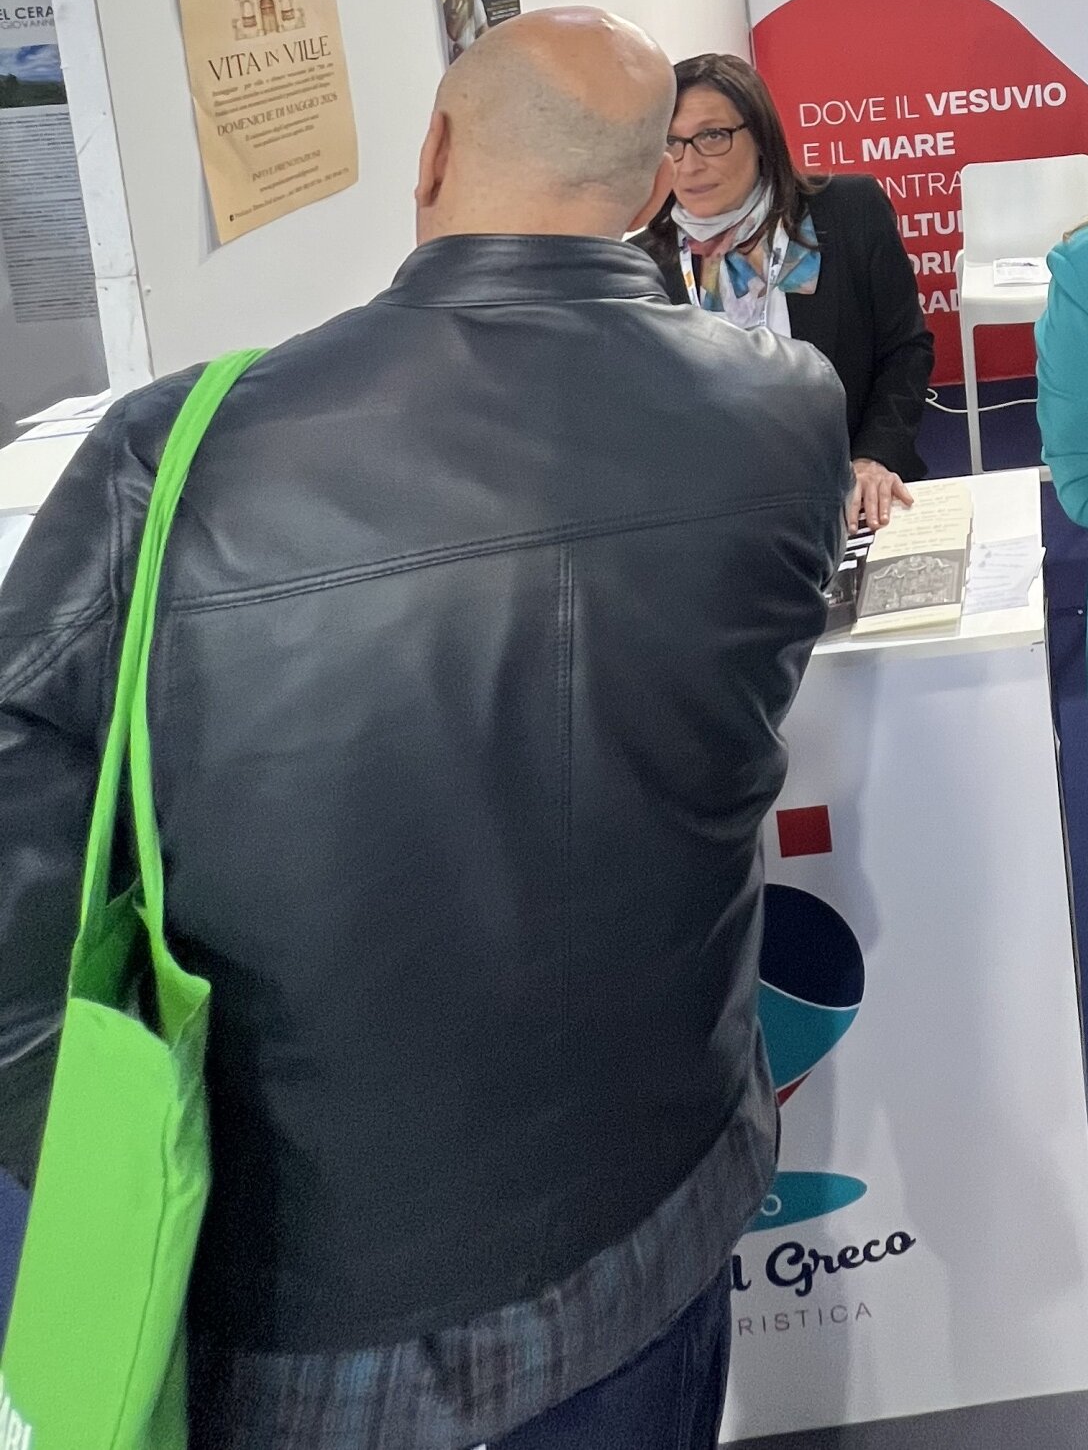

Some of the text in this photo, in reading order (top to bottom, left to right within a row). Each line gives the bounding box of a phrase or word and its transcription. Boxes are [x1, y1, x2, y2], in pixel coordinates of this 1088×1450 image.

[208, 35, 331, 81] VITA IN VILLE
[799, 82, 1068, 128] DOVE IL VESUVIO
[803, 131, 956, 167] E IL MARE
[897, 210, 963, 238] LTU
[760, 1194, 782, 1216] O
[765, 1231, 916, 1297] Greco
[738, 1302, 872, 1337] RISTICA
